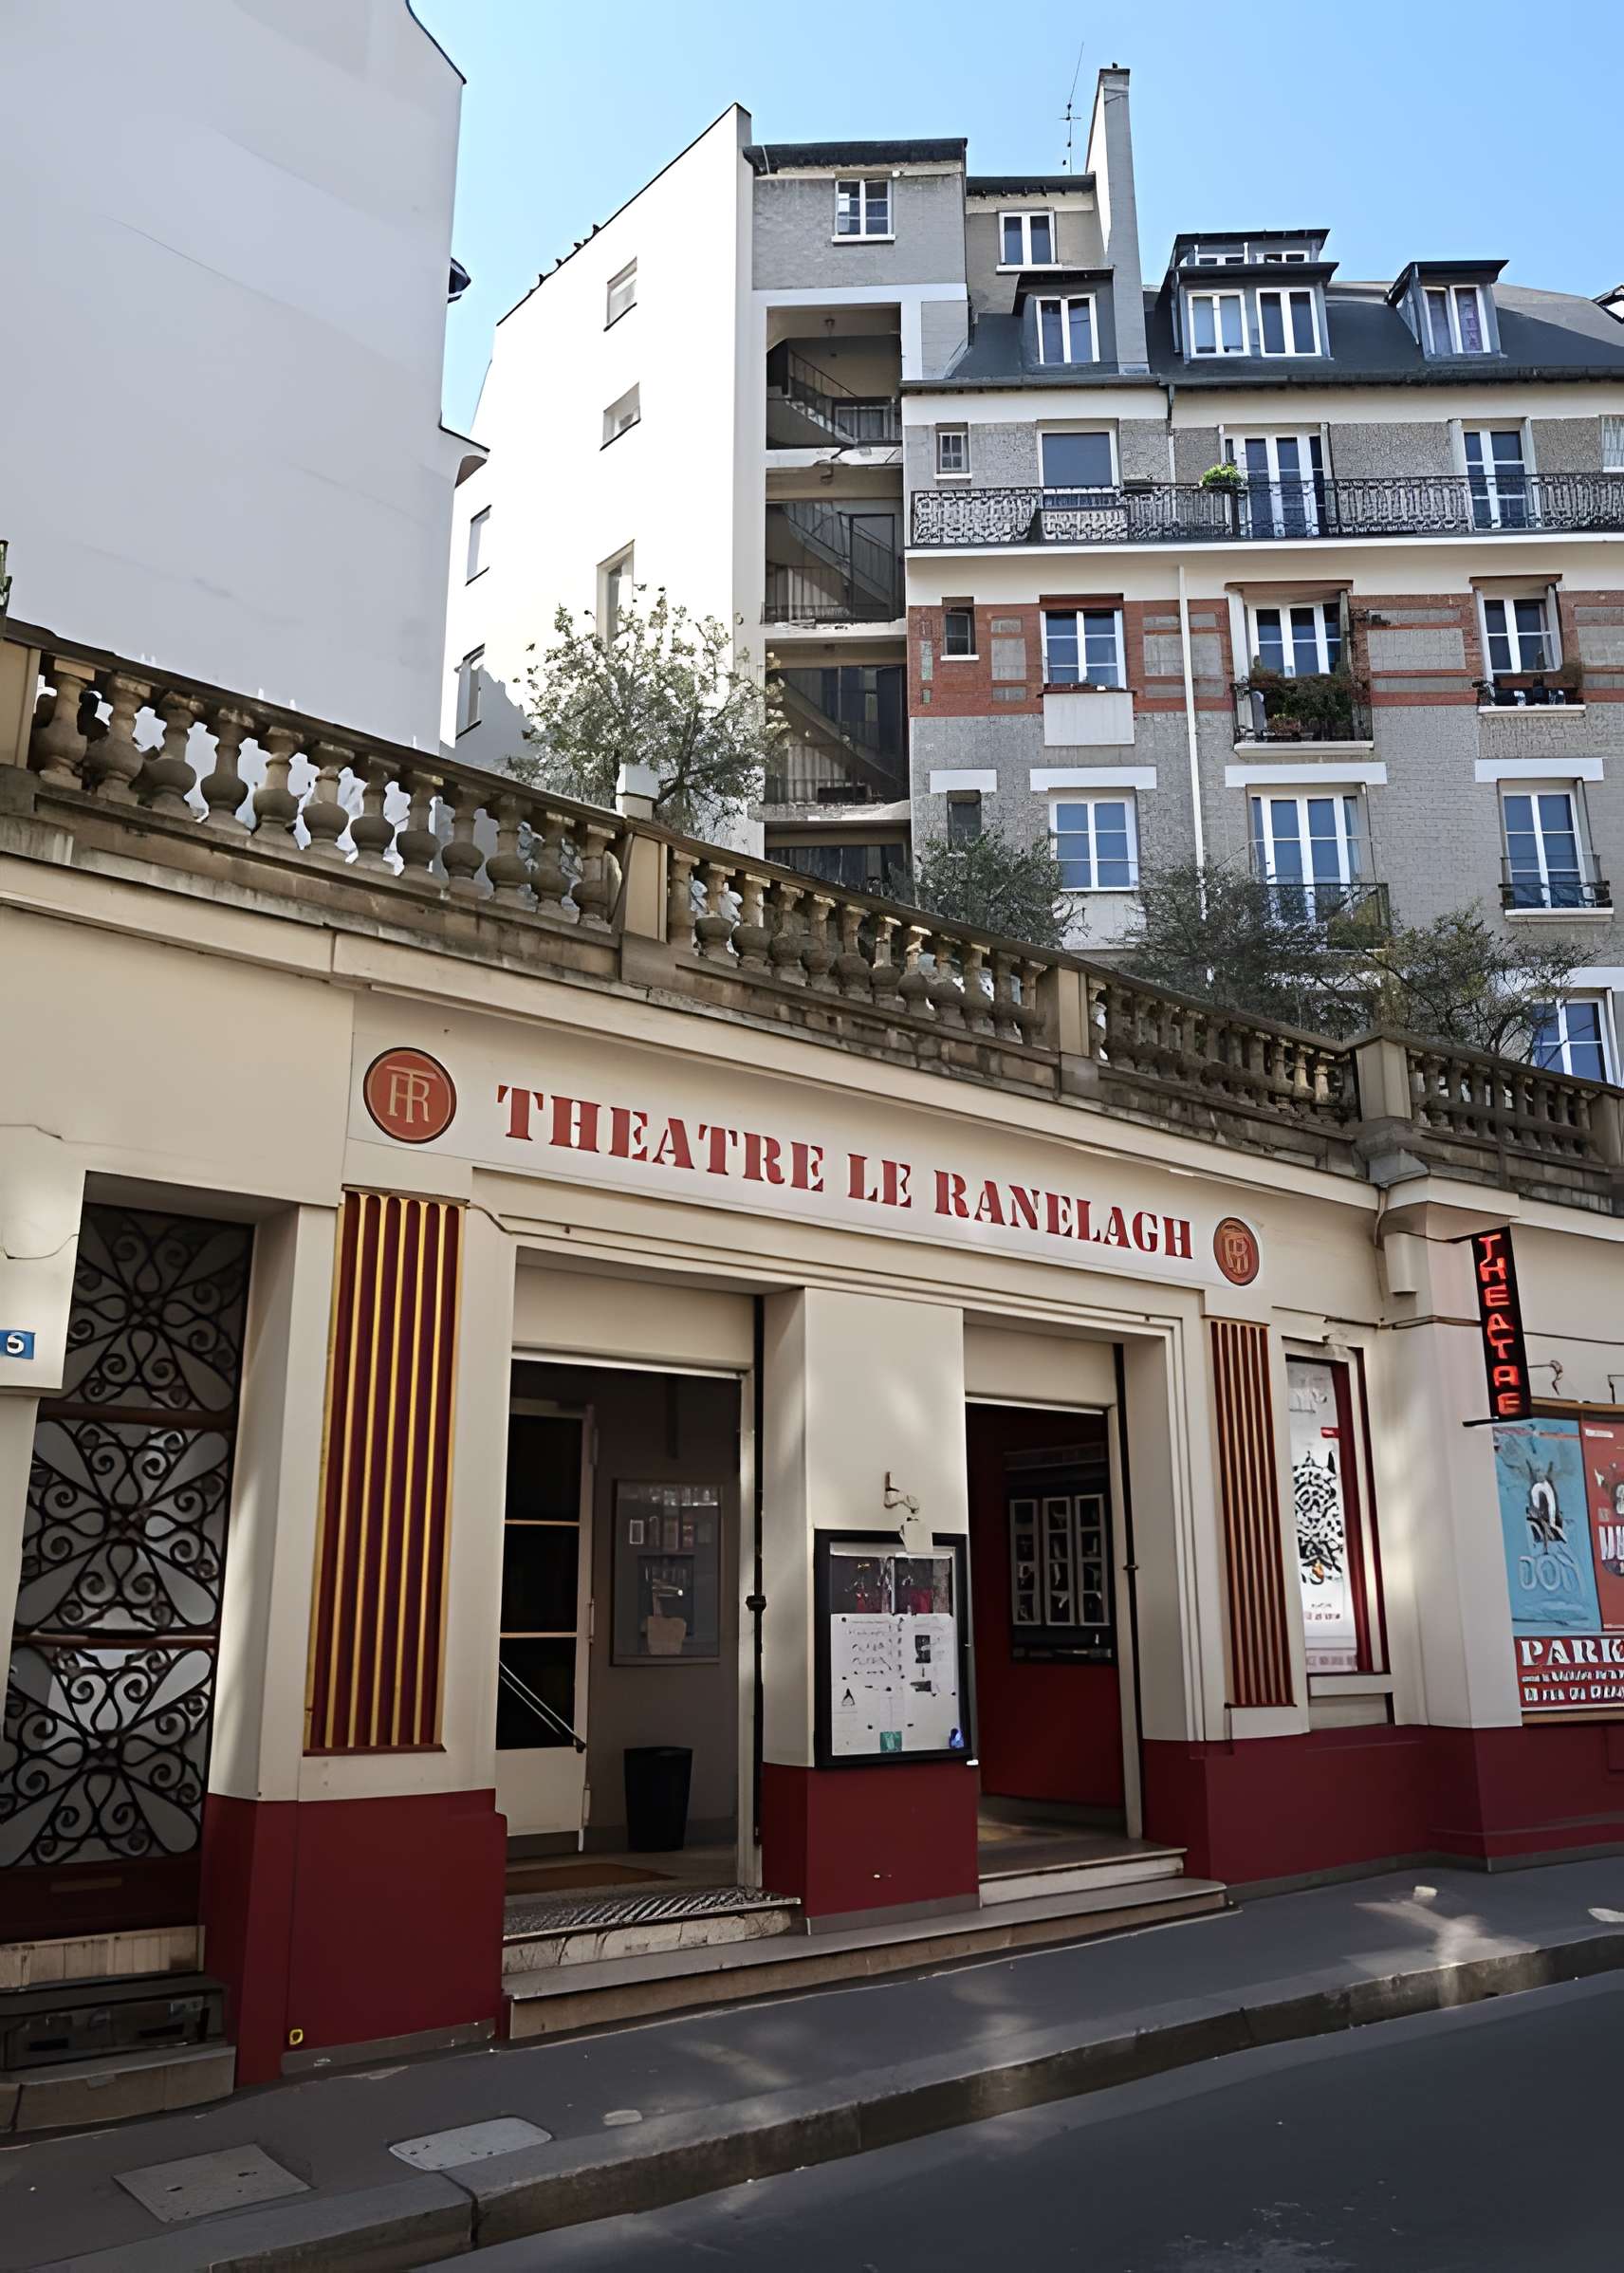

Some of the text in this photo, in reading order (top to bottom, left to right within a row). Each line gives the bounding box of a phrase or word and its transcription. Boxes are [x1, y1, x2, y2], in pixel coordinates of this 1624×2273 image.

[497, 1085, 1194, 1260] THEATRE LE RANELAGH
[1478, 1233, 1522, 1415] THEATRE
